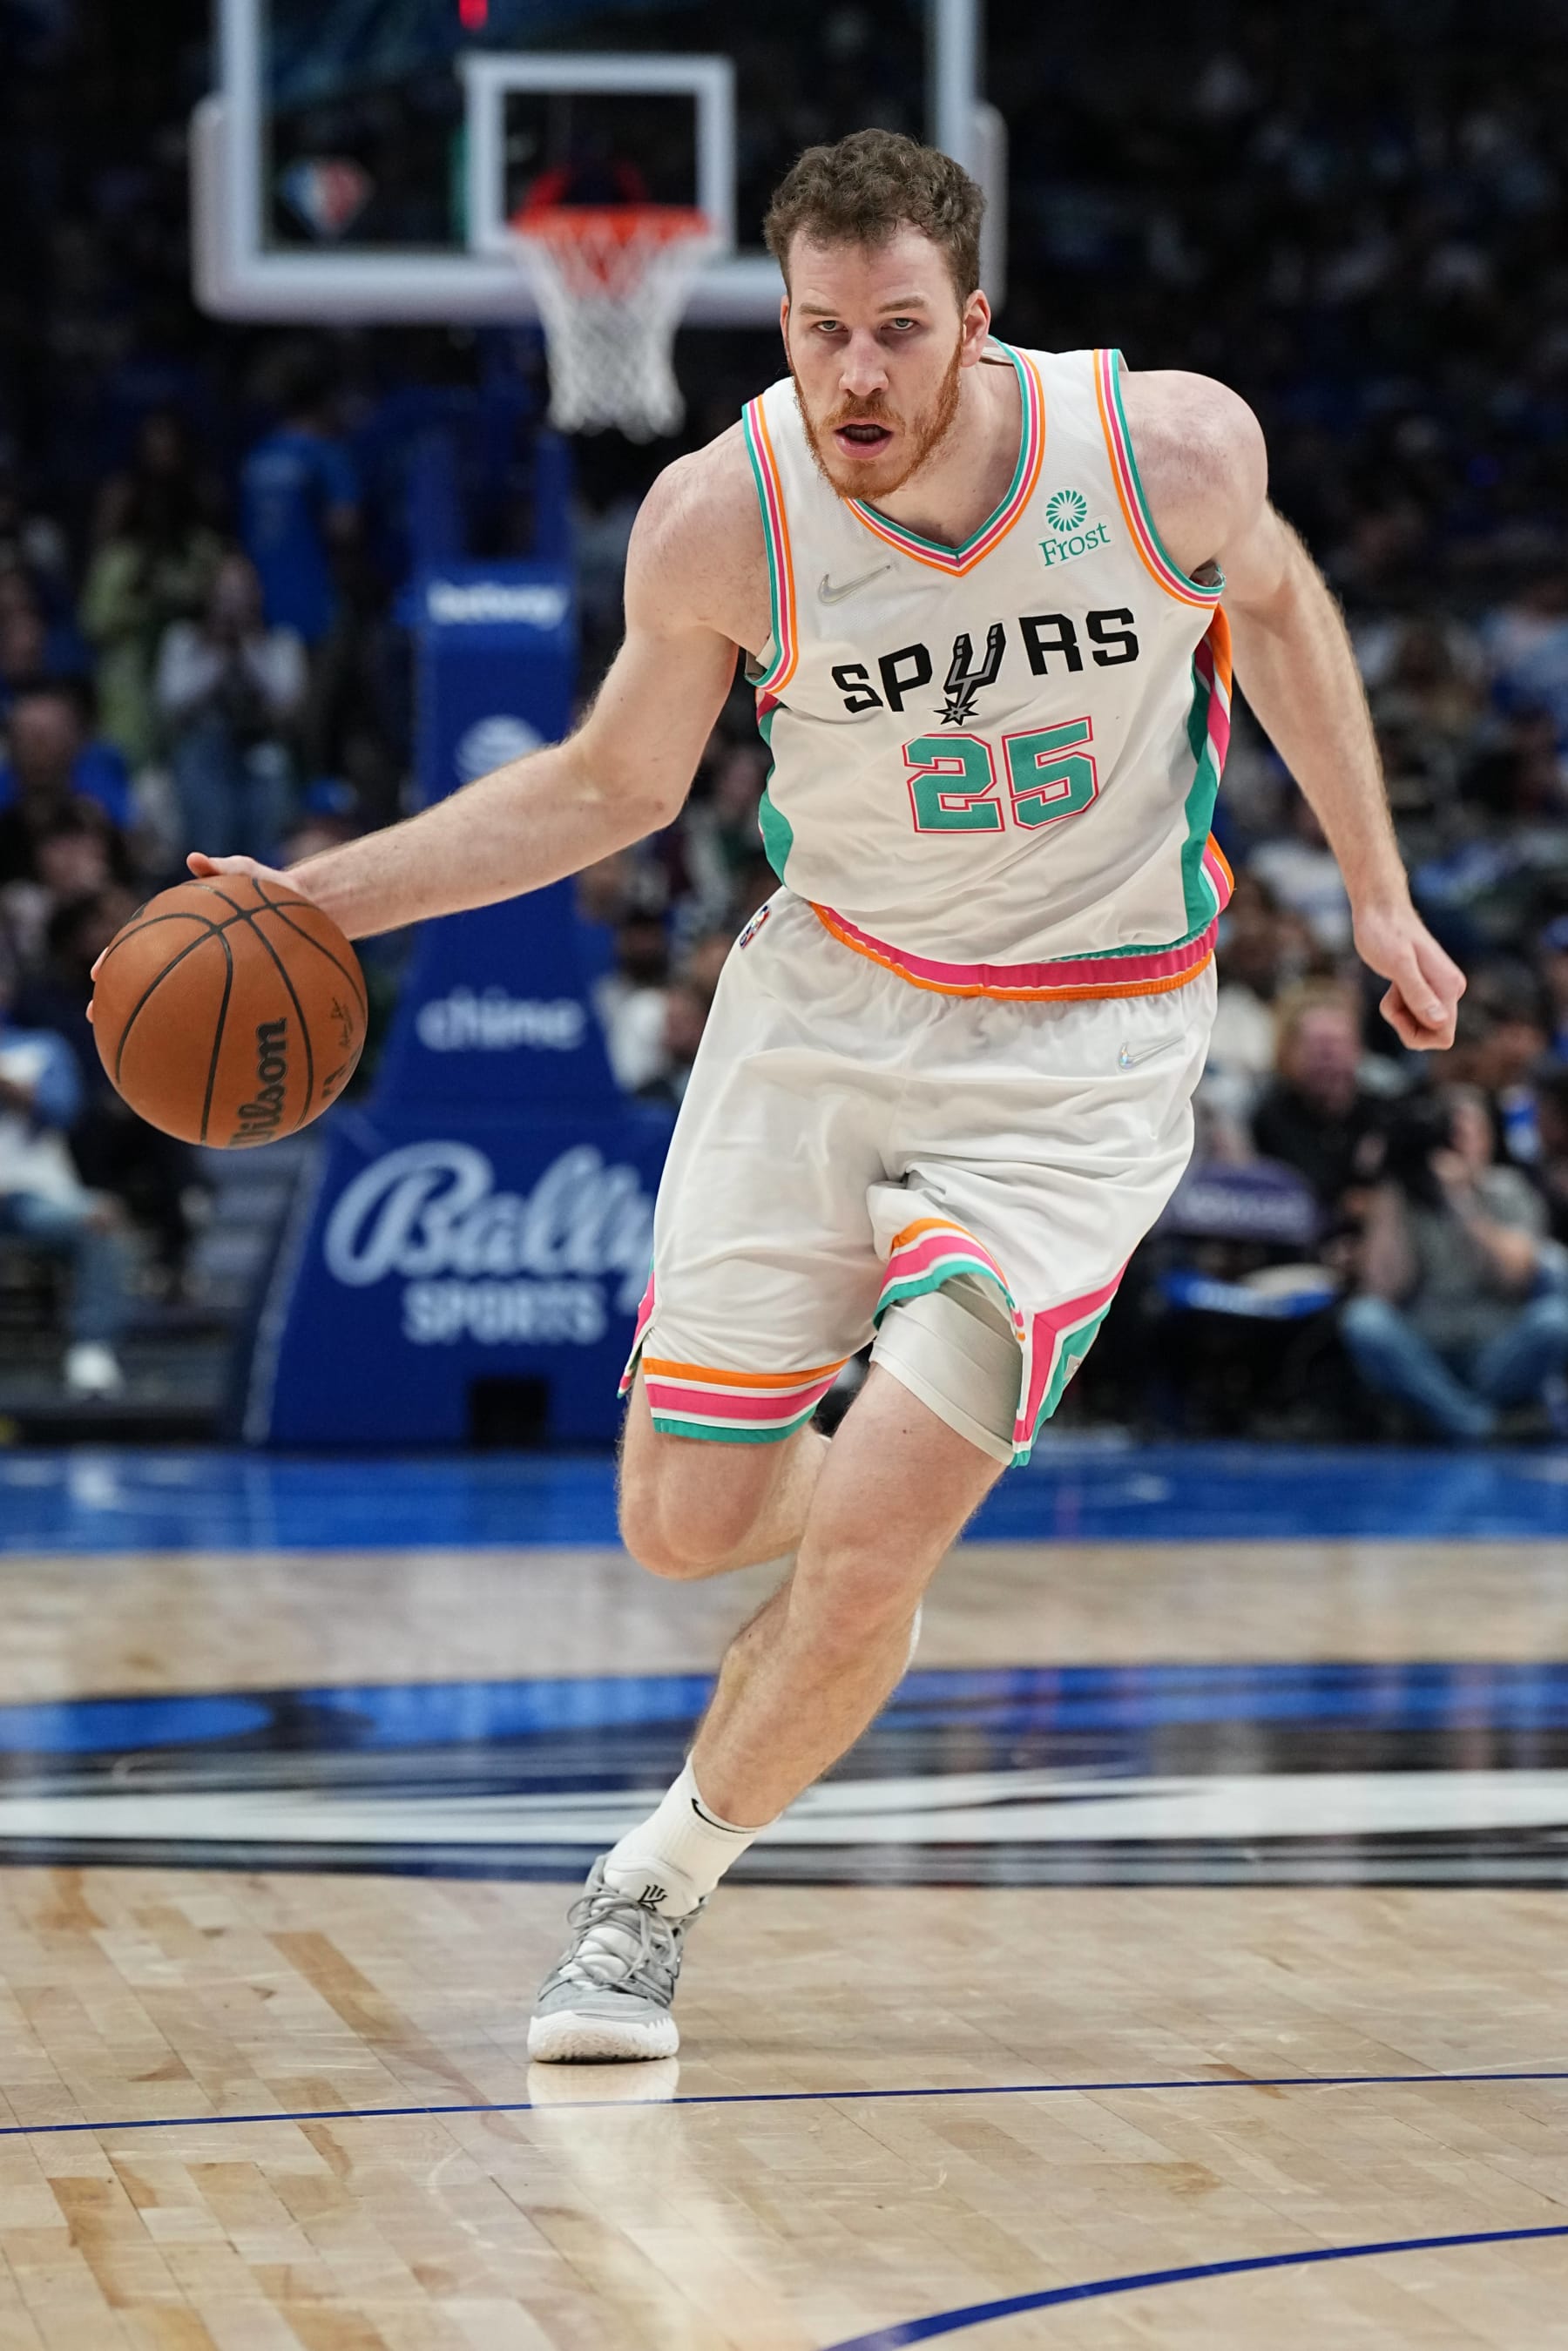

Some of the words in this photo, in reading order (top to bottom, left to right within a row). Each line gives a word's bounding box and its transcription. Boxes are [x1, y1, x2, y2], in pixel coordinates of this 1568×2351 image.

[1038, 523, 1111, 566] Frost
[832, 607, 1139, 726] SPURS
[902, 716, 1099, 834] 25
[403, 1281, 605, 1344] SPORTS
